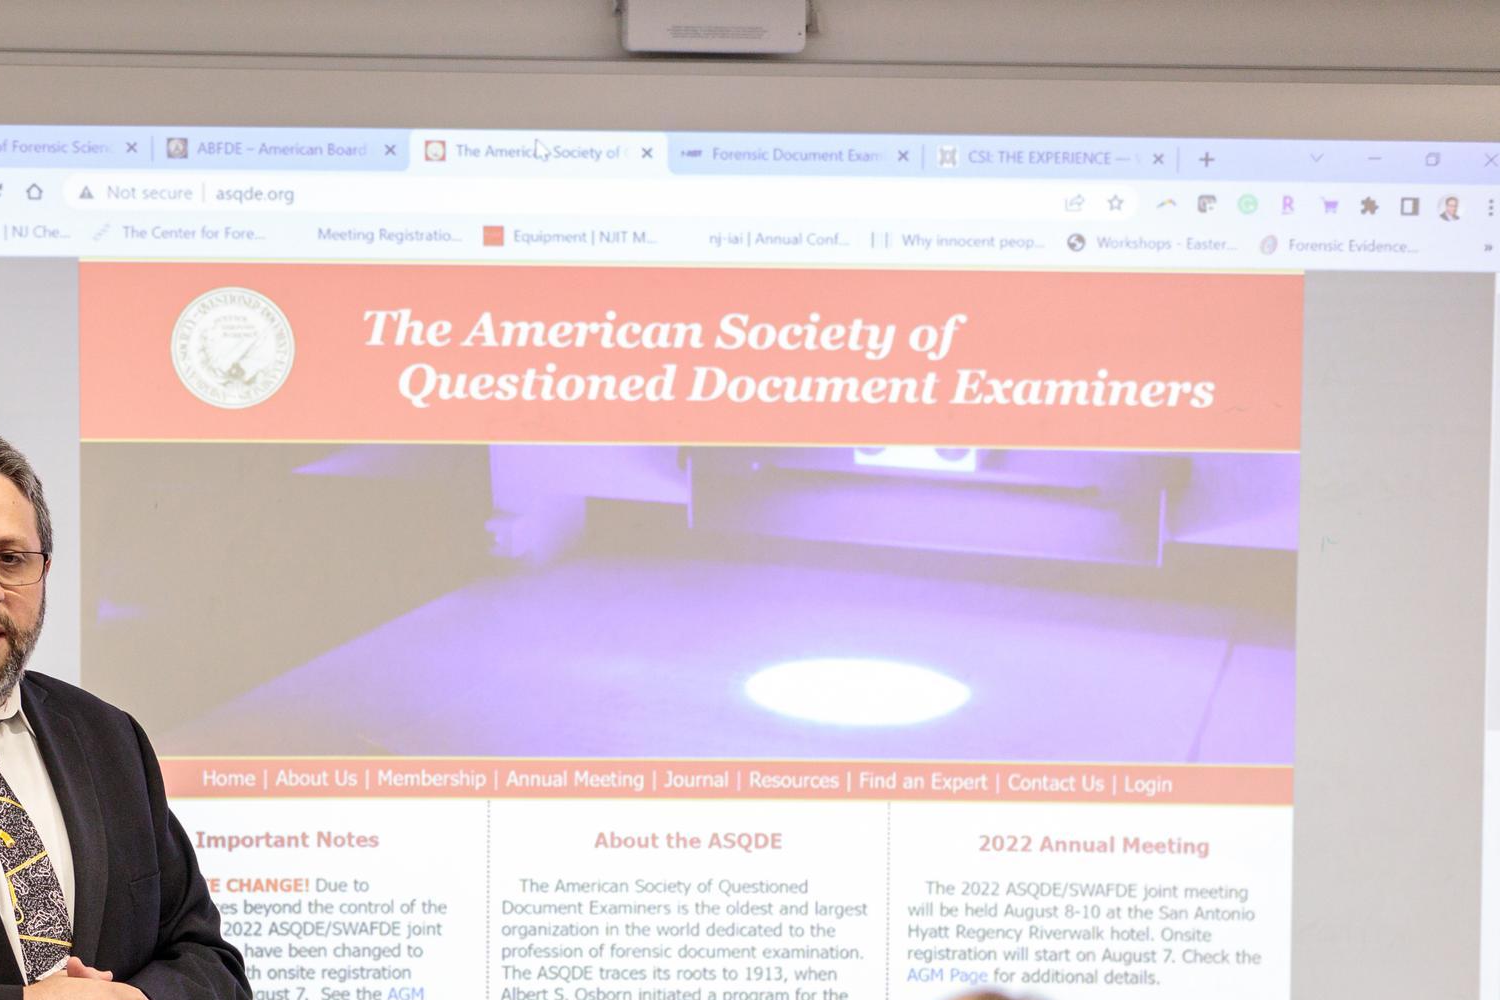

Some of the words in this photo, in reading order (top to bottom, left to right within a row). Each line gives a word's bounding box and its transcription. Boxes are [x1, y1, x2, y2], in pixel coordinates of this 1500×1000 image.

[12, 139, 67, 153] Forensic
[197, 141, 242, 155] ABFDE
[258, 142, 322, 155] American
[712, 147, 768, 160] Forensic
[773, 147, 843, 161] Document
[107, 185, 135, 199] Not
[142, 189, 192, 199] secure
[216, 186, 294, 205] asqde.org
[122, 225, 147, 238] The
[151, 226, 196, 239] Center
[200, 224, 219, 239] for
[317, 227, 374, 244] Meeting
[901, 233, 932, 250] Why
[936, 234, 994, 247] innocent
[1096, 236, 1171, 252] Workshops
[1289, 238, 1343, 252] Forensic
[363, 307, 451, 347] The
[460, 308, 703, 349] American
[714, 311, 896, 360] Society
[908, 313, 967, 361] of
[398, 361, 676, 409] Questioned
[686, 366, 939, 404] Document
[948, 367, 1215, 408] Examiners
[202, 769, 255, 786] Home
[275, 768, 328, 786] About
[334, 769, 357, 786] Us
[377, 769, 486, 790] Membership
[506, 769, 567, 787] Annual
[573, 770, 644, 791] Meeting
[663, 770, 728, 788] Journal
[749, 771, 839, 788] Resources
[859, 771, 896, 789] Find
[902, 776, 924, 789] an
[931, 772, 987, 793] Expert
[1008, 773, 1076, 791] Contact
[1081, 774, 1104, 792] Us
[1124, 775, 1172, 796] Login
[196, 831, 309, 852] Important
[317, 831, 379, 847] Notes
[594, 831, 659, 848] About
[666, 831, 701, 848] the
[708, 832, 781, 853] ASQDE
[979, 834, 1031, 852] 2022
[1039, 834, 1114, 853] Annual
[1122, 836, 1209, 858] Meeting
[226, 878, 309, 892] CHANGE!
[316, 877, 347, 892] Due
[353, 879, 369, 892] to
[519, 878, 549, 893] The
[554, 878, 628, 893] American
[635, 879, 691, 895] Society
[696, 878, 713, 893] of
[718, 879, 808, 897] Questioned
[925, 880, 955, 895] The
[961, 881, 999, 896] 2022
[1005, 881, 1137, 901] ASQDE/SWAFDE
[1142, 884, 1178, 902] joint
[1184, 885, 1248, 903] meeting
[243, 899, 301, 917] beyond
[308, 898, 333, 914] the
[339, 899, 393, 914] control
[400, 898, 416, 914] of
[421, 899, 447, 914] the
[502, 899, 583, 915] Document
[589, 900, 671, 915] Examiners
[676, 900, 689, 915] is
[695, 900, 720, 915] the
[726, 900, 773, 915] oldest
[779, 901, 808, 915] and
[815, 900, 867, 919] largest
[907, 901, 933, 916] will
[940, 902, 958, 917] be
[965, 902, 997, 917] held
[1003, 903, 1058, 921] August
[1064, 904, 1100, 919] 8-10
[1106, 906, 1121, 919] at
[1127, 904, 1153, 920] the
[1159, 905, 1188, 920] San
[1194, 906, 1255, 921] Antonio
[223, 921, 262, 937] 2022
[268, 920, 400, 939] ASQDE/SWAFDE
[406, 922, 442, 939] joint
[501, 922, 598, 940] organization
[605, 922, 618, 935] in
[625, 922, 650, 936] the
[656, 922, 699, 936] world
[706, 922, 782, 937] dedicated
[788, 924, 804, 937] to
[810, 923, 835, 937] the
[908, 924, 949, 941] Hyatt
[956, 924, 1022, 942] Regency
[1029, 924, 1103, 940] Riverwalk
[1110, 926, 1154, 941] hotel.
[1160, 926, 1211, 942] Onsite
[244, 942, 283, 958] have
[288, 943, 327, 958] been
[333, 942, 400, 961] changed
[407, 944, 423, 957] to
[501, 943, 583, 961] profession
[588, 943, 605, 958] of
[610, 943, 671, 958] forensic
[677, 944, 756, 959] document
[762, 945, 863, 959] examination.
[907, 946, 996, 964] registration
[1003, 946, 1028, 960] will
[1034, 948, 1070, 962] start
[1076, 950, 1095, 962] on
[1101, 947, 1156, 966] August
[1163, 948, 1175, 963] 7.
[1182, 948, 1229, 964] Check
[1235, 949, 1261, 964] the
[267, 965, 315, 980] onsite
[321, 965, 411, 983] registration
[907, 967, 943, 982] AGM
[950, 968, 987, 985] Page
[994, 968, 1015, 983] for
[1021, 968, 1097, 984] additional
[1103, 969, 1159, 985] details.
[296, 986, 308, 1000] 7.
[321, 986, 350, 1000] See
[356, 986, 381, 1000] the
[387, 987, 423, 1000] AGM
